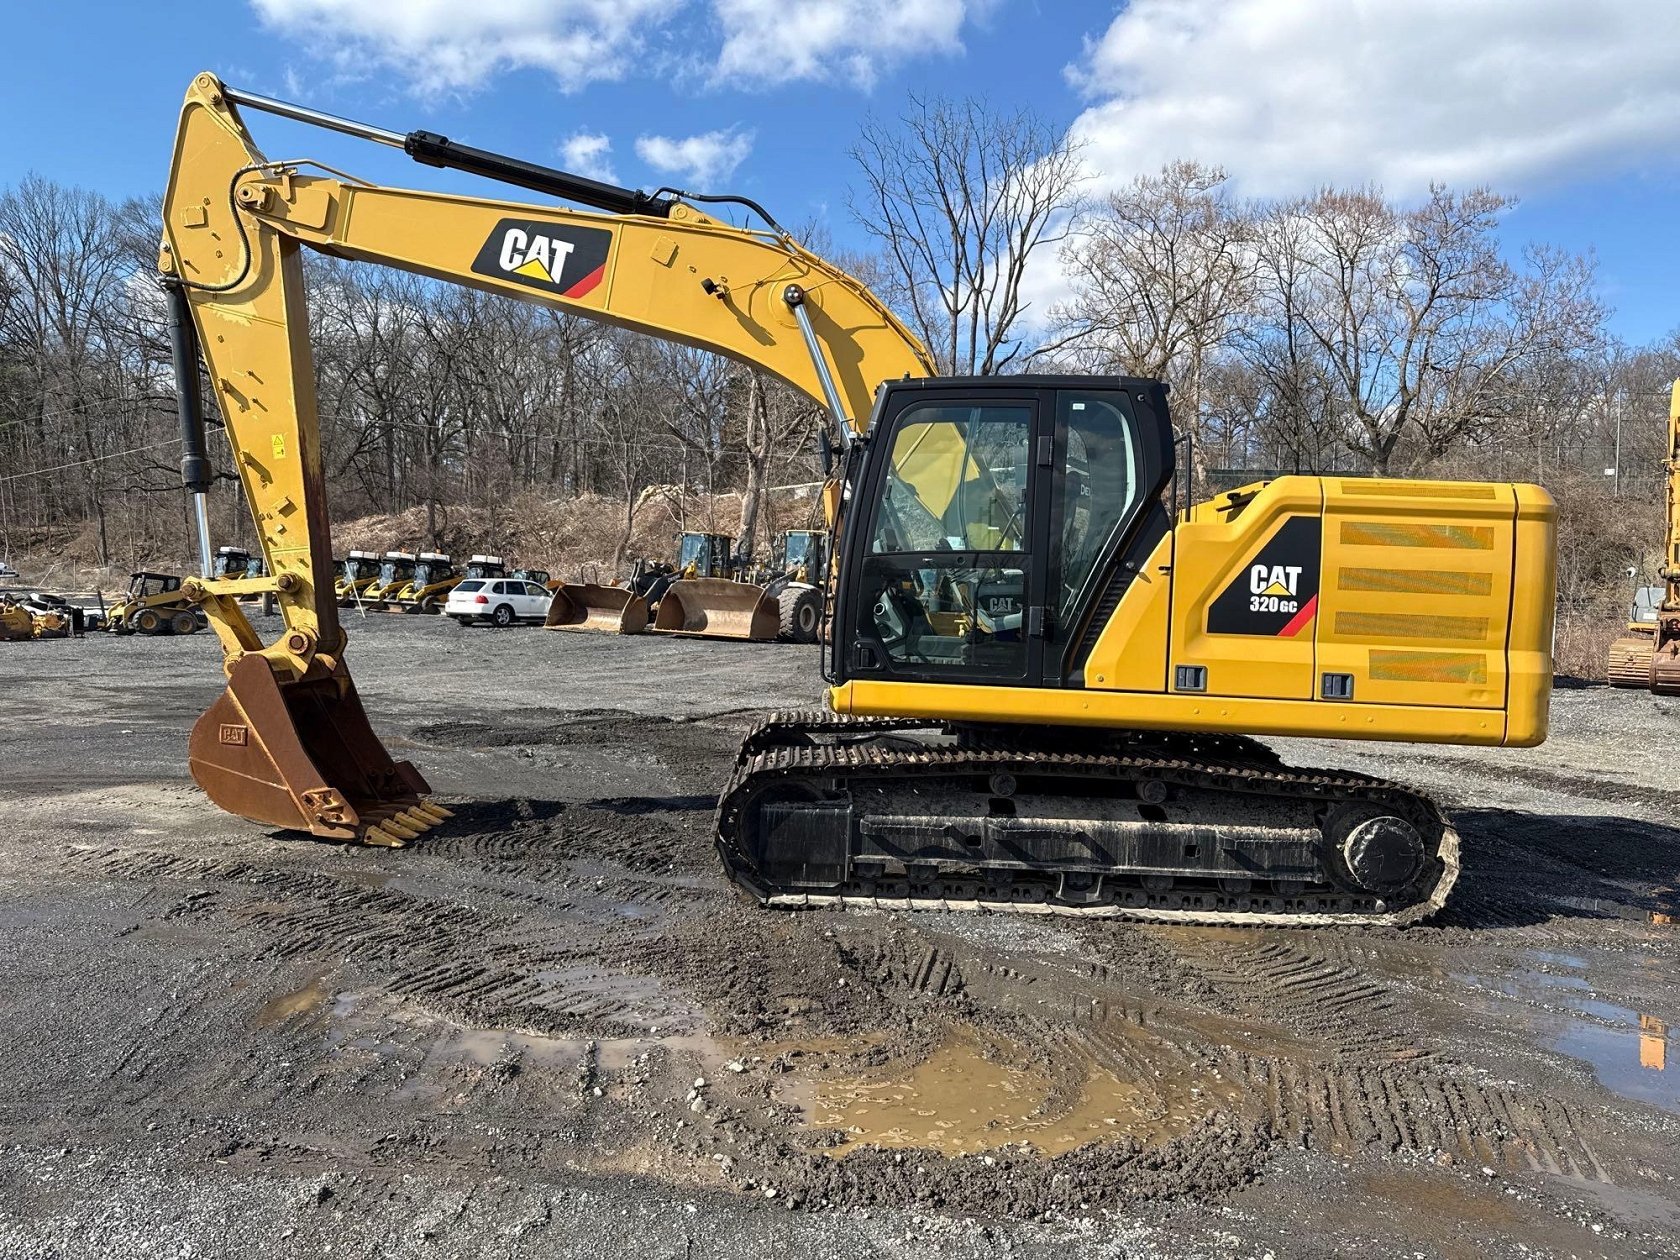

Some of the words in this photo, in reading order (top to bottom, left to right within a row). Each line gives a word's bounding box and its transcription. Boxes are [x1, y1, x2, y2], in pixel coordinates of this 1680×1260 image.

[499, 228, 575, 285] CAT
[1250, 564, 1303, 597] CAT
[990, 597, 1014, 613] CAT
[1249, 596, 1279, 612] 320
[1279, 600, 1298, 613] GC
[223, 728, 245, 743] CAT
